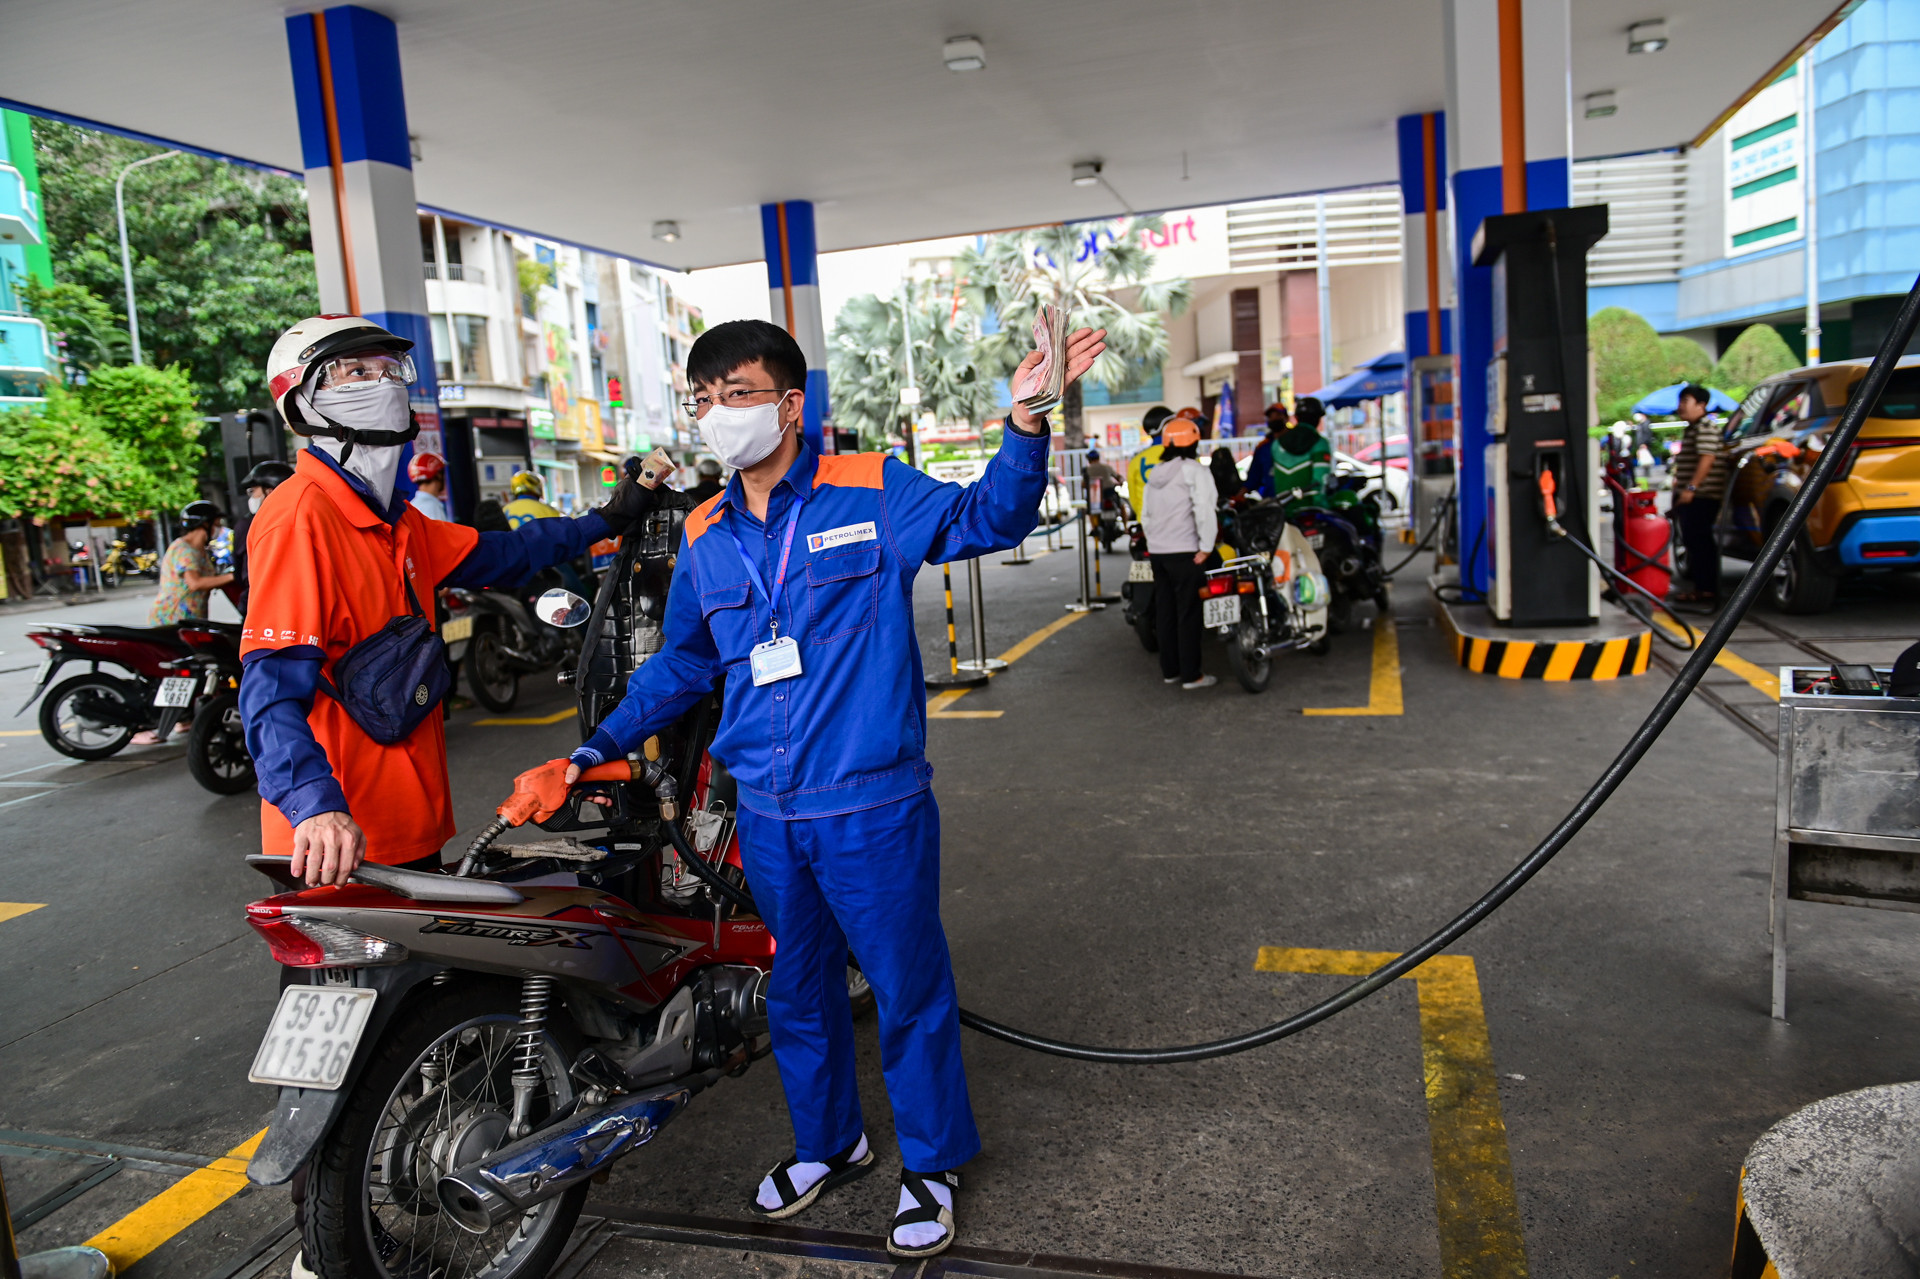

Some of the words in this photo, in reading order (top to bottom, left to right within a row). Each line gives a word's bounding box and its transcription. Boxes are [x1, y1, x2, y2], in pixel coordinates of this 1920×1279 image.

[824, 528, 873, 542] PETROLIMEX
[286, 992, 358, 1034] 59-S1
[261, 1036, 350, 1080] 115.36
